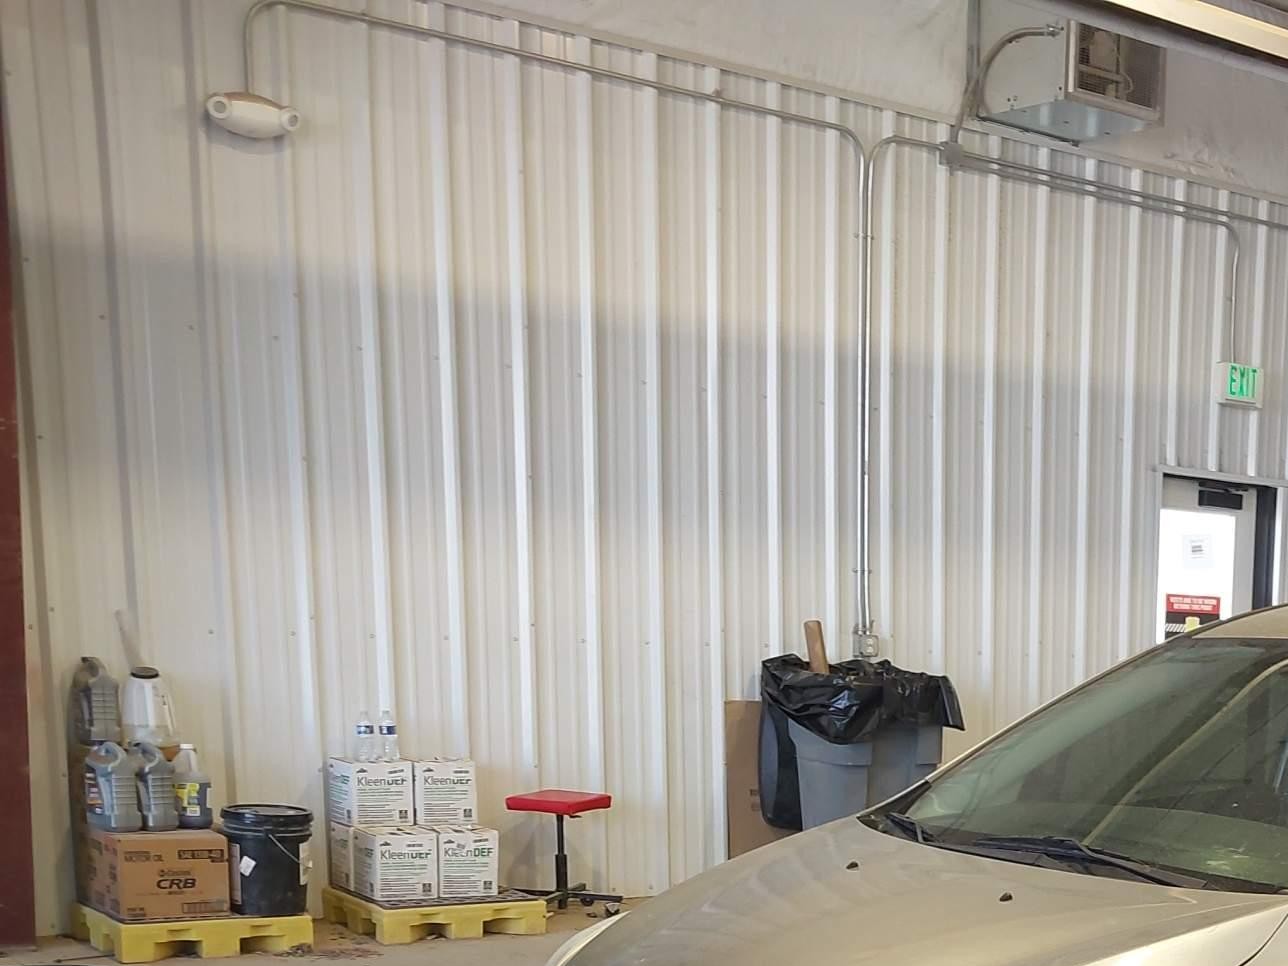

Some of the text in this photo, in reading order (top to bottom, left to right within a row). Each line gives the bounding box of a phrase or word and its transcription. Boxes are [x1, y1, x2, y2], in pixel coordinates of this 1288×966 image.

[1230, 365, 1257, 398] EXIT
[380, 849, 432, 860] KleenDEF
[156, 878, 196, 889] CRB
